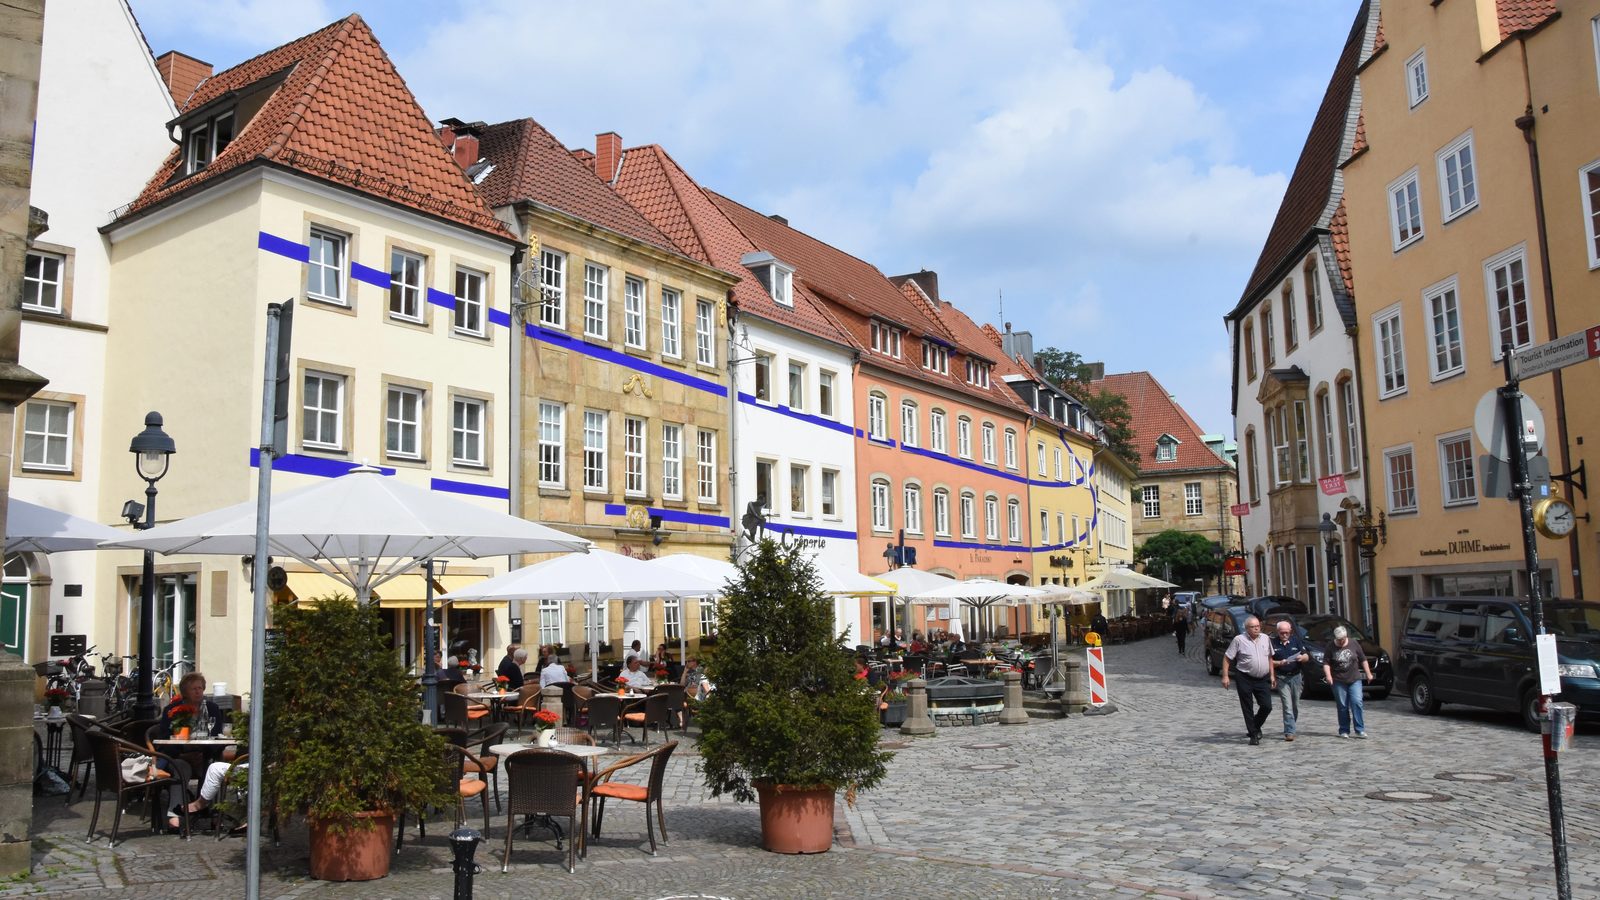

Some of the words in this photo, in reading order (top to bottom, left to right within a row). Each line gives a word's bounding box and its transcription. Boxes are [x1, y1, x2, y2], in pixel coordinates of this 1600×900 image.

[1520, 350, 1542, 364] Tourist
[1543, 337, 1585, 357] Information
[1448, 540, 1482, 555] DUHME
